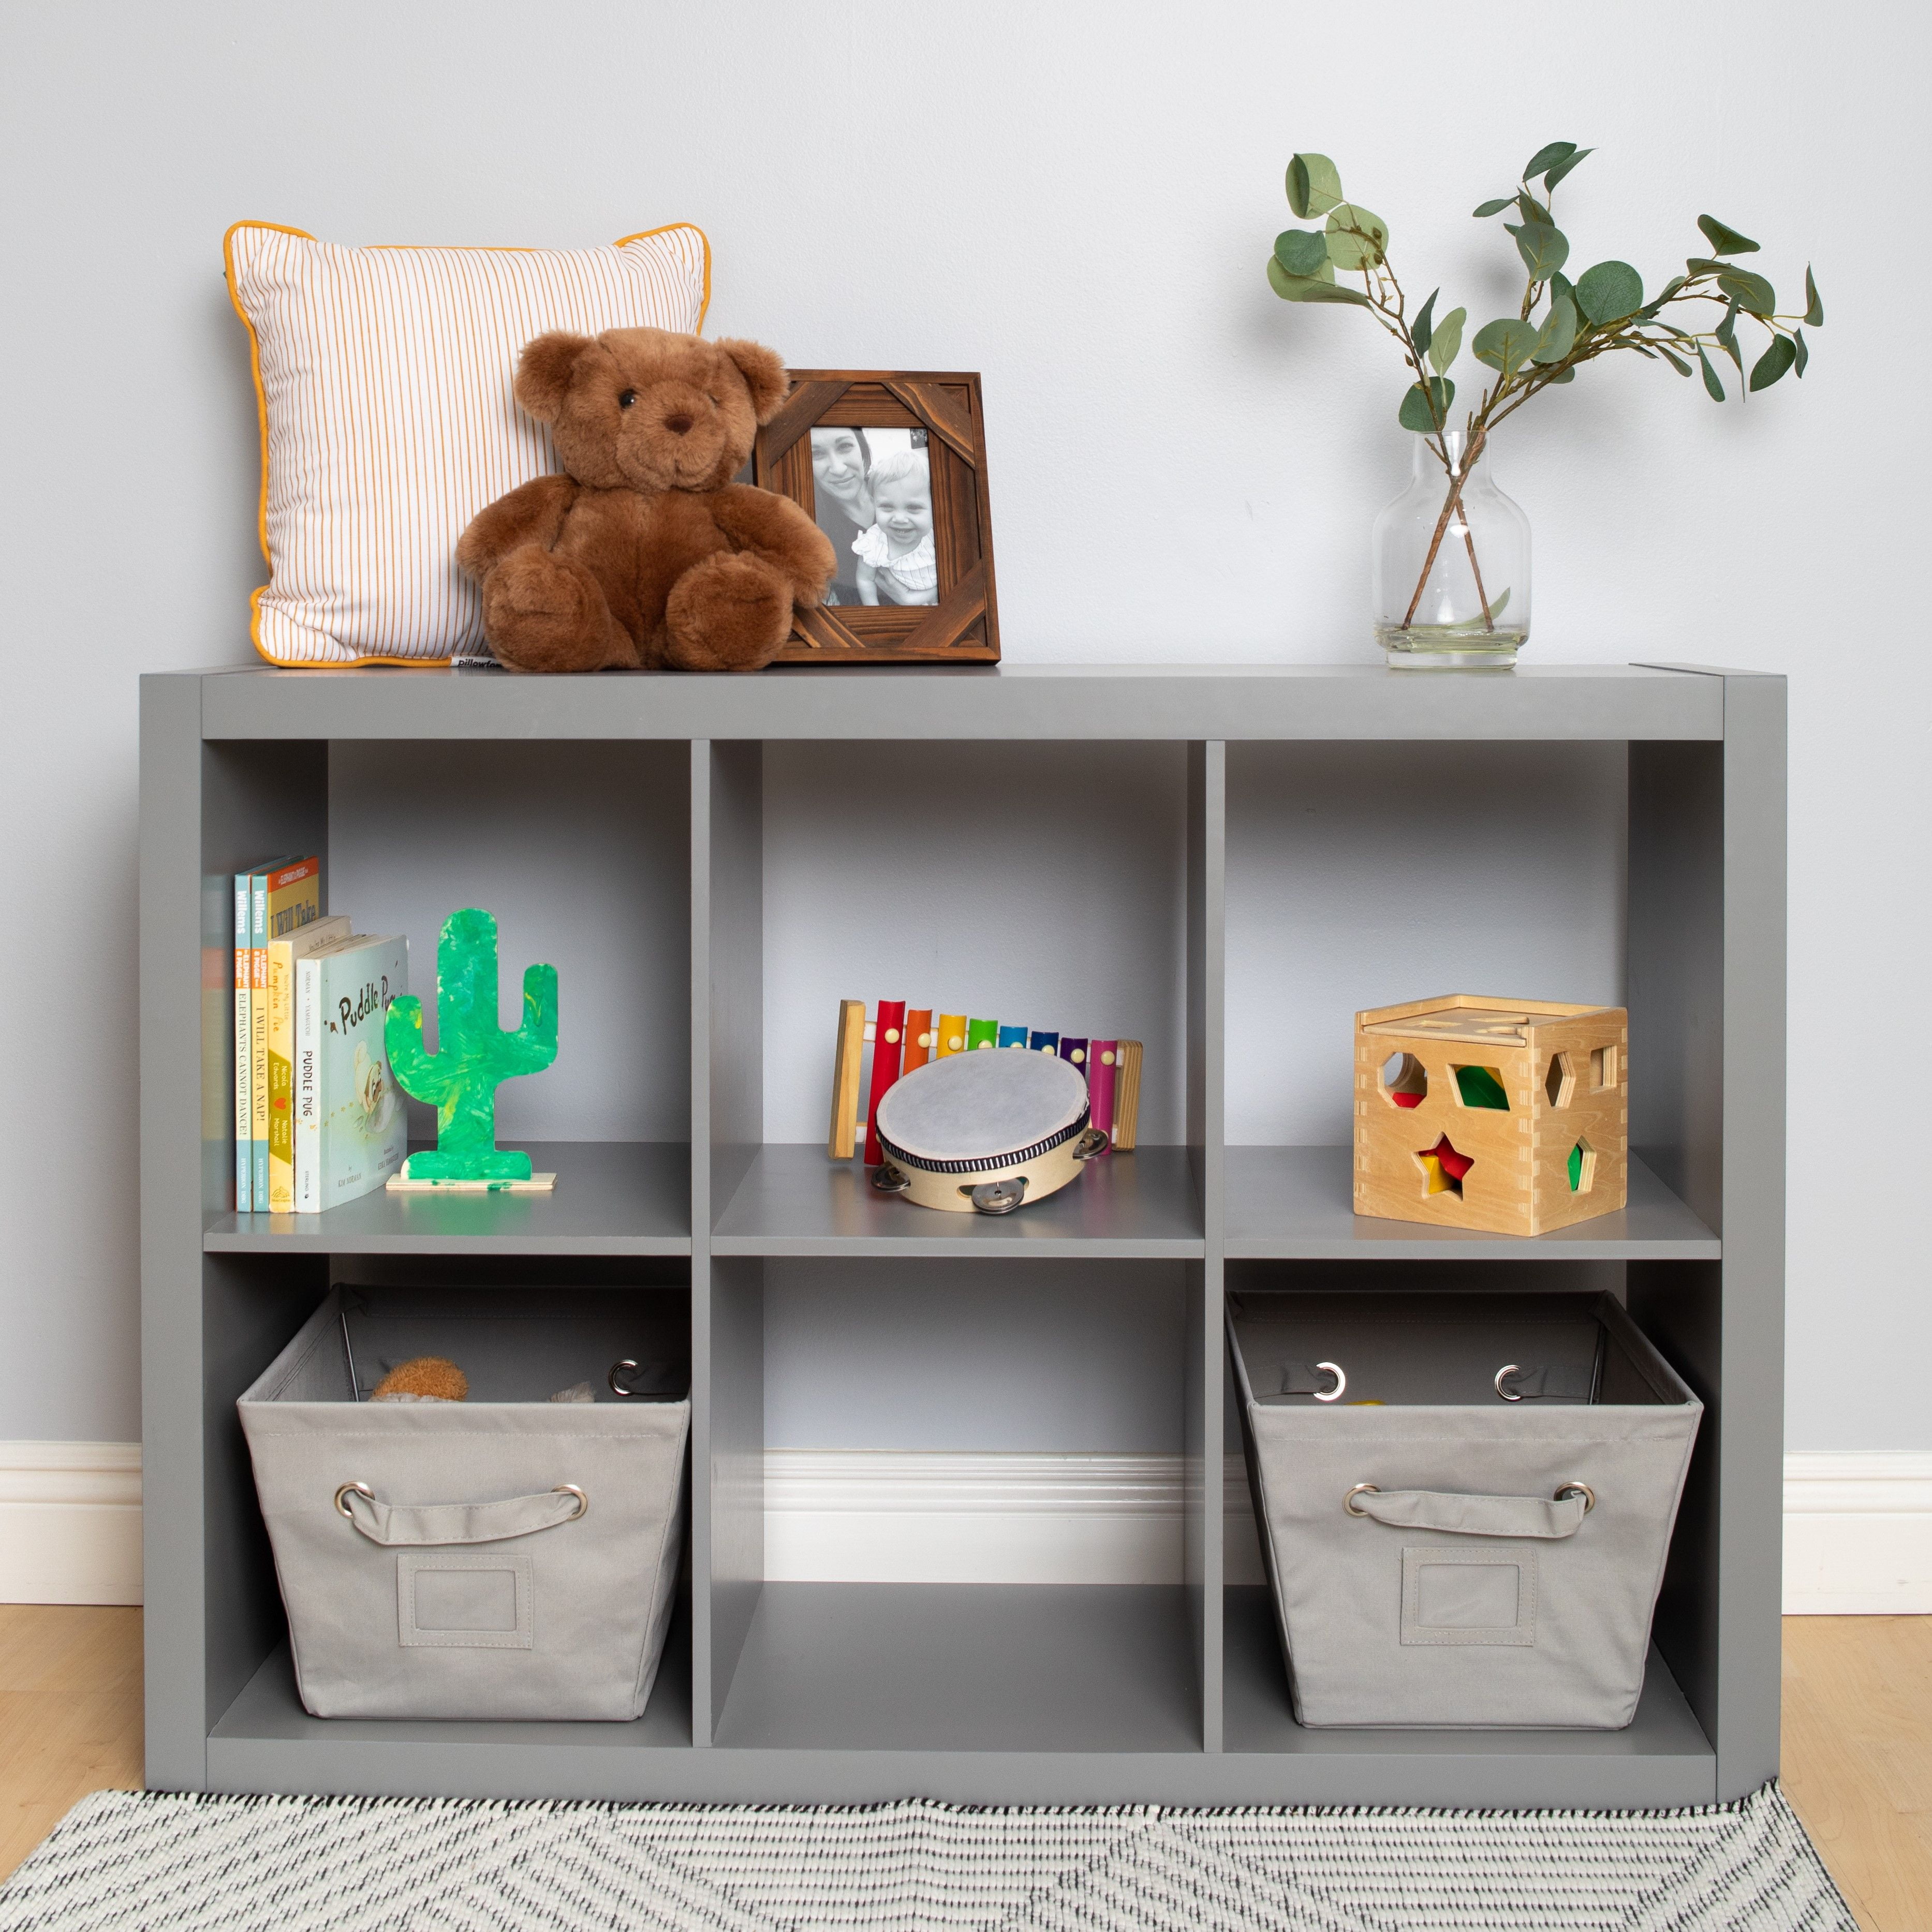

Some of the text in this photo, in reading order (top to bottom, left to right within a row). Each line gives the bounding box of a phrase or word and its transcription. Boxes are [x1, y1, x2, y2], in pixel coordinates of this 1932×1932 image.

[237, 890, 247, 934] Willems
[254, 890, 265, 934] Willems
[269, 962, 284, 1033] Pumpkin Pie
[283, 993, 289, 1001] My
[339, 982, 379, 1035] Puddle
[256, 1015, 265, 1044] WILL
[256, 1048, 265, 1080] TAKE
[303, 1051, 313, 1116] PUDDLE PUG
[256, 1095, 265, 1122] NAP!
